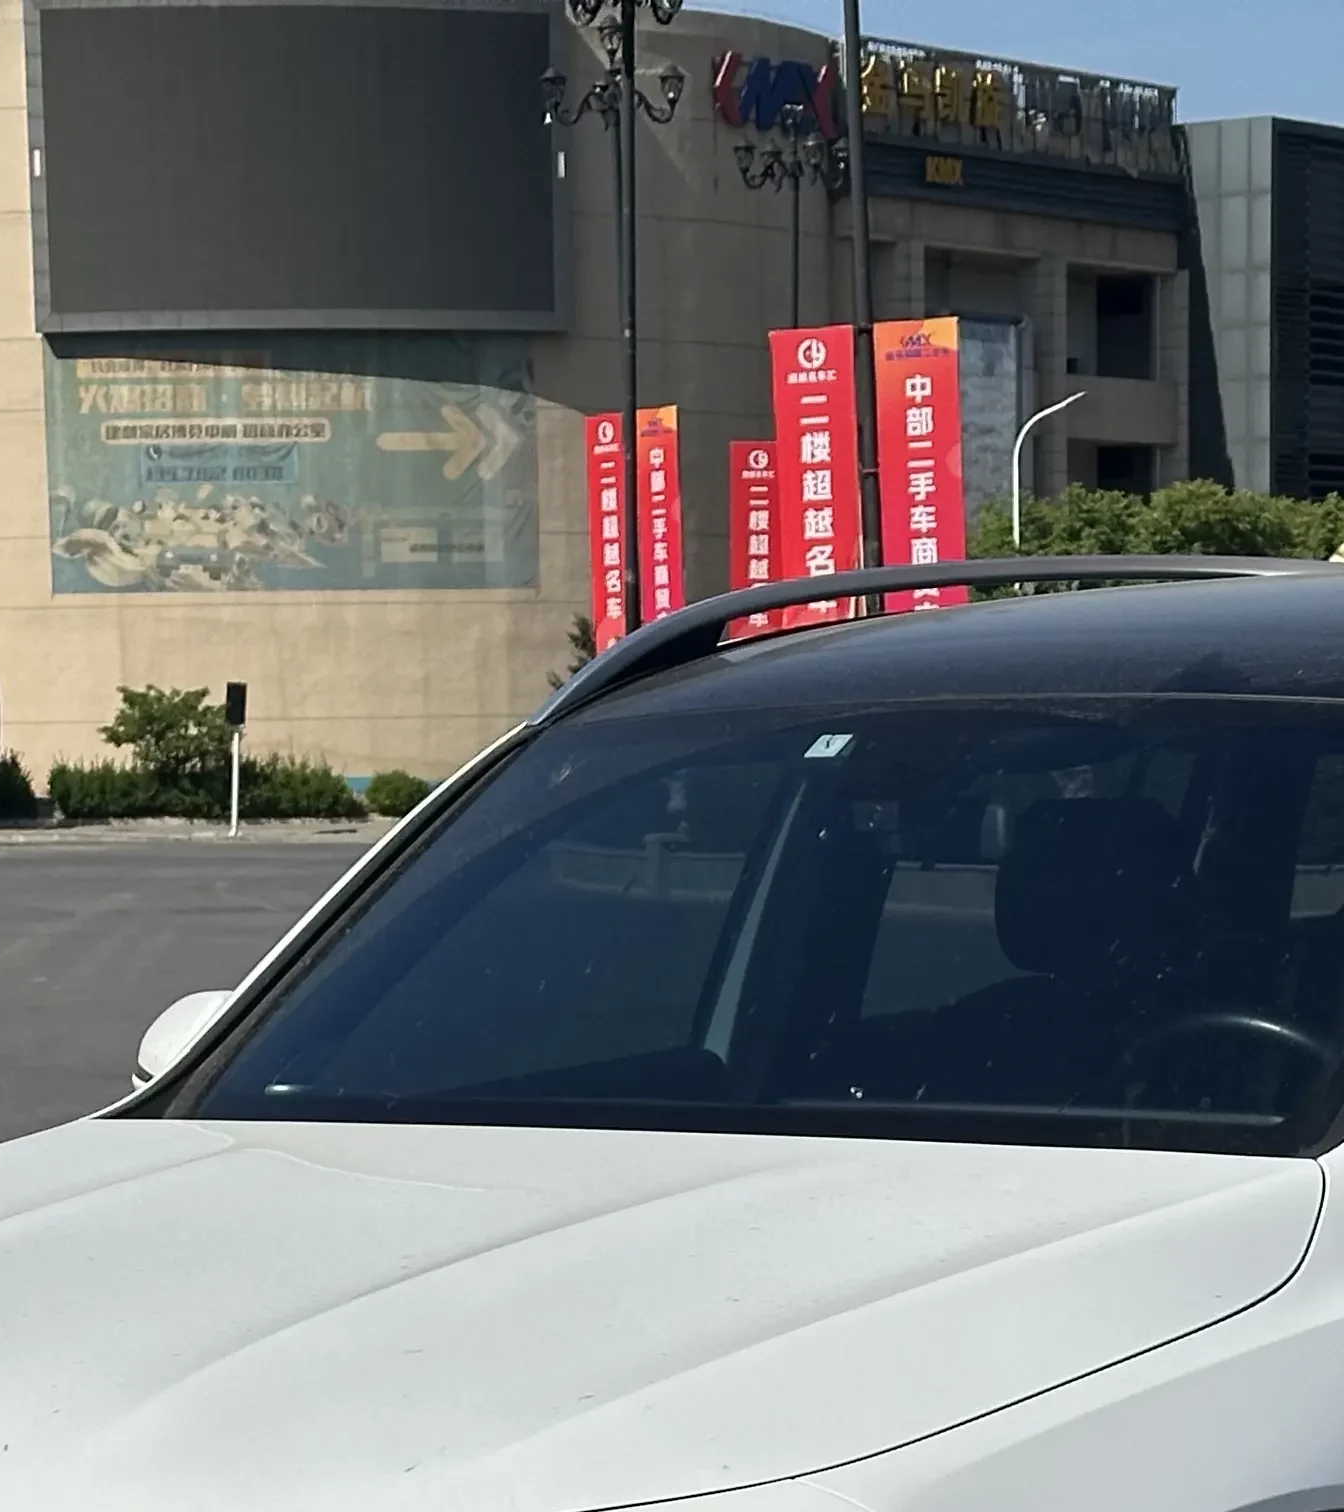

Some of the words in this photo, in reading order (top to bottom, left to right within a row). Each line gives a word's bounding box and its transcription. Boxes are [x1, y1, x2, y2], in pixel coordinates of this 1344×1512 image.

[748, 486, 770, 626] 二楼超越车
[905, 374, 940, 608] 中部二手车商
